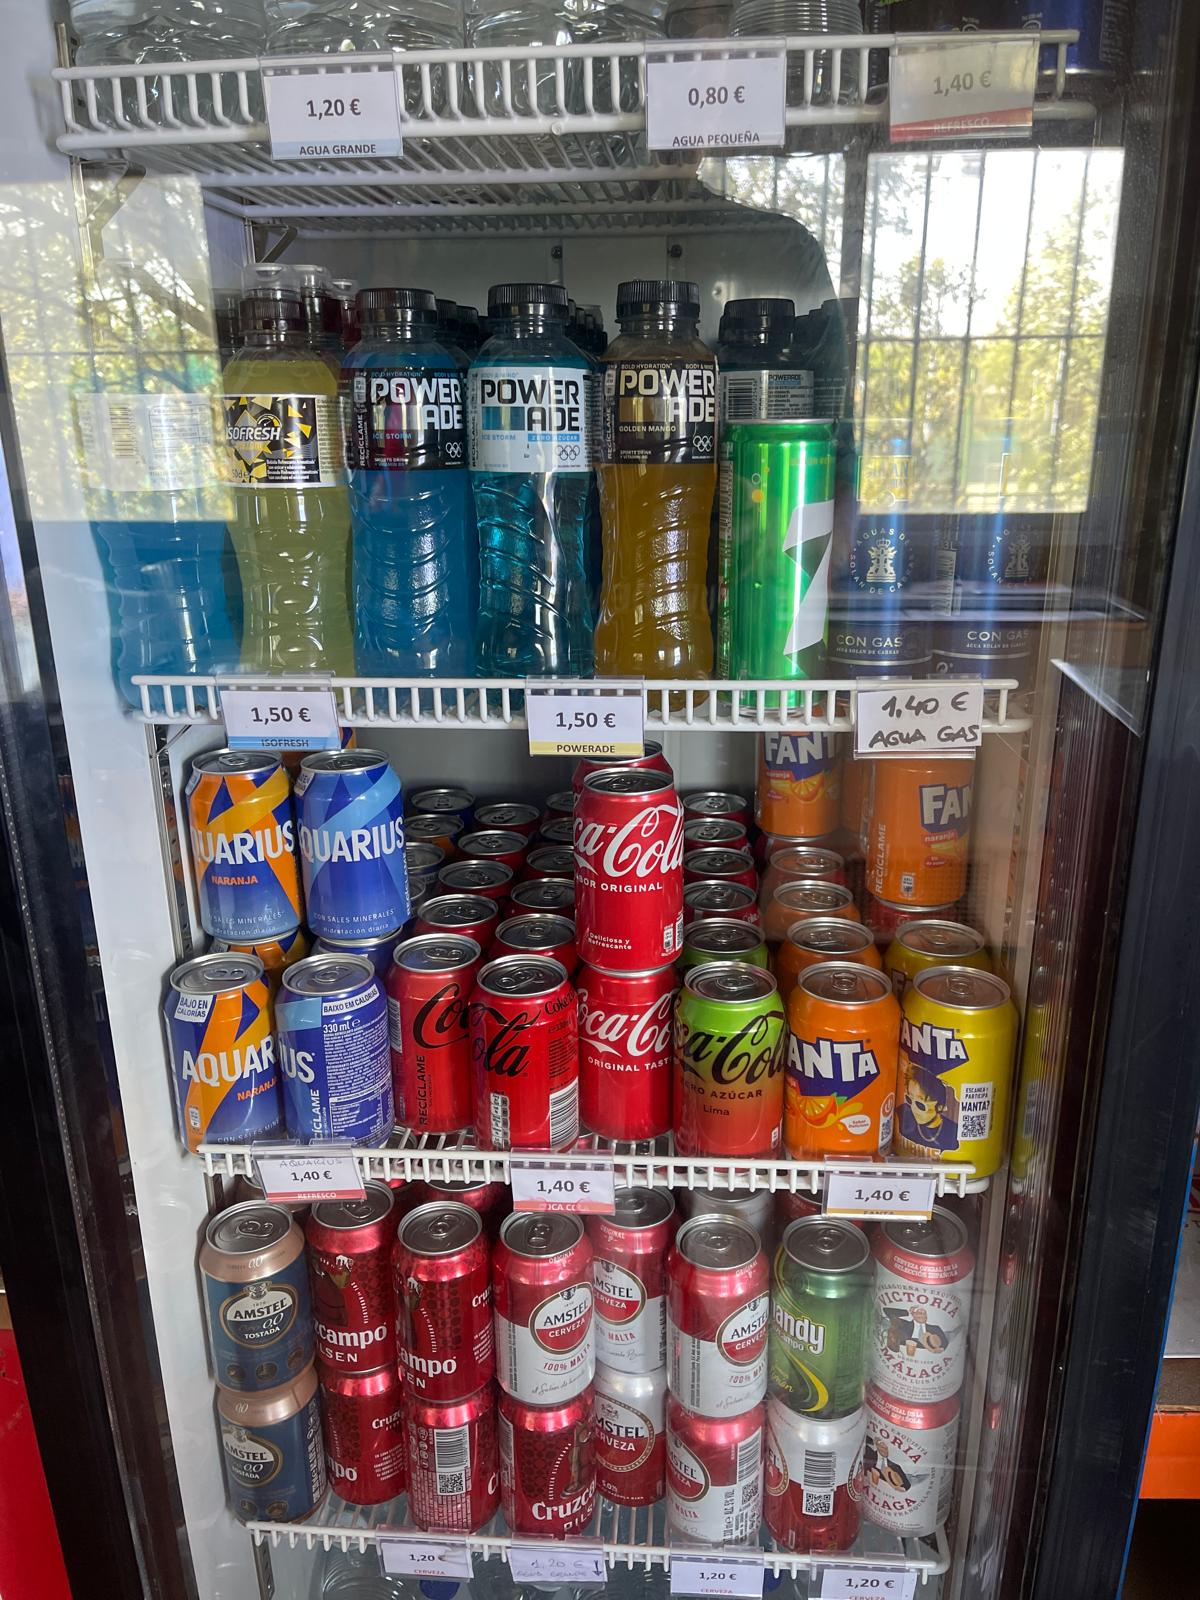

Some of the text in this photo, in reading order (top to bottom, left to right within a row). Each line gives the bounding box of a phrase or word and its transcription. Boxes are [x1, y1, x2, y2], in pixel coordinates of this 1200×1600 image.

[933, 70, 992, 97] 1,40 €
[688, 86, 745, 109] 0,80 €
[306, 99, 361, 120] 1,20 €
[672, 131, 760, 147] AGUA PEQUEÑA
[300, 144, 376, 155] AGUA GRANDE
[370, 377, 463, 404] POWER
[480, 379, 580, 405] POWER
[620, 369, 715, 396] POWER
[422, 404, 464, 430] ADE
[527, 406, 580, 432] ADE
[668, 396, 715, 423] ADE
[836, 634, 904, 648] CON GAS
[967, 630, 1001, 642] CON
[950, 691, 970, 712] €
[251, 707, 312, 724] 1,50 €
[556, 712, 616, 730] 1,50 €
[261, 738, 309, 748] ISOFRESH
[868, 724, 980, 749] AGUA GAS
[556, 744, 616, 753] POWERADE
[765, 732, 835, 765] FANT
[921, 785, 972, 826] FAN
[192, 819, 296, 865] UARIUS
[300, 816, 405, 864] QUARIUS
[211, 875, 258, 886] NARANJA
[600, 882, 663, 893] ORIGINAL
[352, 908, 395, 923] MINERALES
[589, 932, 623, 944] Deliciosa
[179, 997, 208, 1009] BAJO EN
[323, 987, 379, 1014] BAIXO EM CALORIAS
[177, 1007, 206, 1018] CALORÍAS
[322, 1021, 350, 1034] 330 ml
[901, 1018, 967, 1060] ANTA
[182, 1035, 276, 1087] AQUAR
[588, 1056, 673, 1072] ORIGINAL TAST
[788, 1035, 878, 1082] ANTA
[237, 1076, 277, 1101] NARANJ
[685, 1082, 763, 1100] ERO AZÚCAR
[703, 1105, 730, 1116] Lima
[961, 1101, 990, 1112] WANTA?
[291, 1170, 333, 1182] 1,40 €
[537, 1180, 591, 1194] 1,40 €
[854, 1189, 911, 1202] 1,40 €
[595, 1276, 633, 1299] MSTEL
[234, 1297, 288, 1319] AMSTEL
[594, 1291, 627, 1310] ERVEZA
[878, 1291, 959, 1318] VICTORIA
[543, 1298, 589, 1327] AMSTEL
[244, 1326, 280, 1339] TOSTADA
[314, 1322, 388, 1349] campo
[548, 1318, 586, 1338] CERVEZA
[608, 1331, 636, 1342] MALTA
[773, 1302, 825, 1355] andy
[543, 1362, 567, 1371] 100%
[596, 1414, 645, 1439] MSTEL
[595, 1427, 636, 1452] ERVEZA
[867, 1420, 922, 1464] TORIA
[669, 1450, 698, 1480] STEL
[409, 1554, 435, 1563] 1,20
[699, 1572, 737, 1583] 1,20 €
[845, 1578, 895, 1589] 1,20 €
